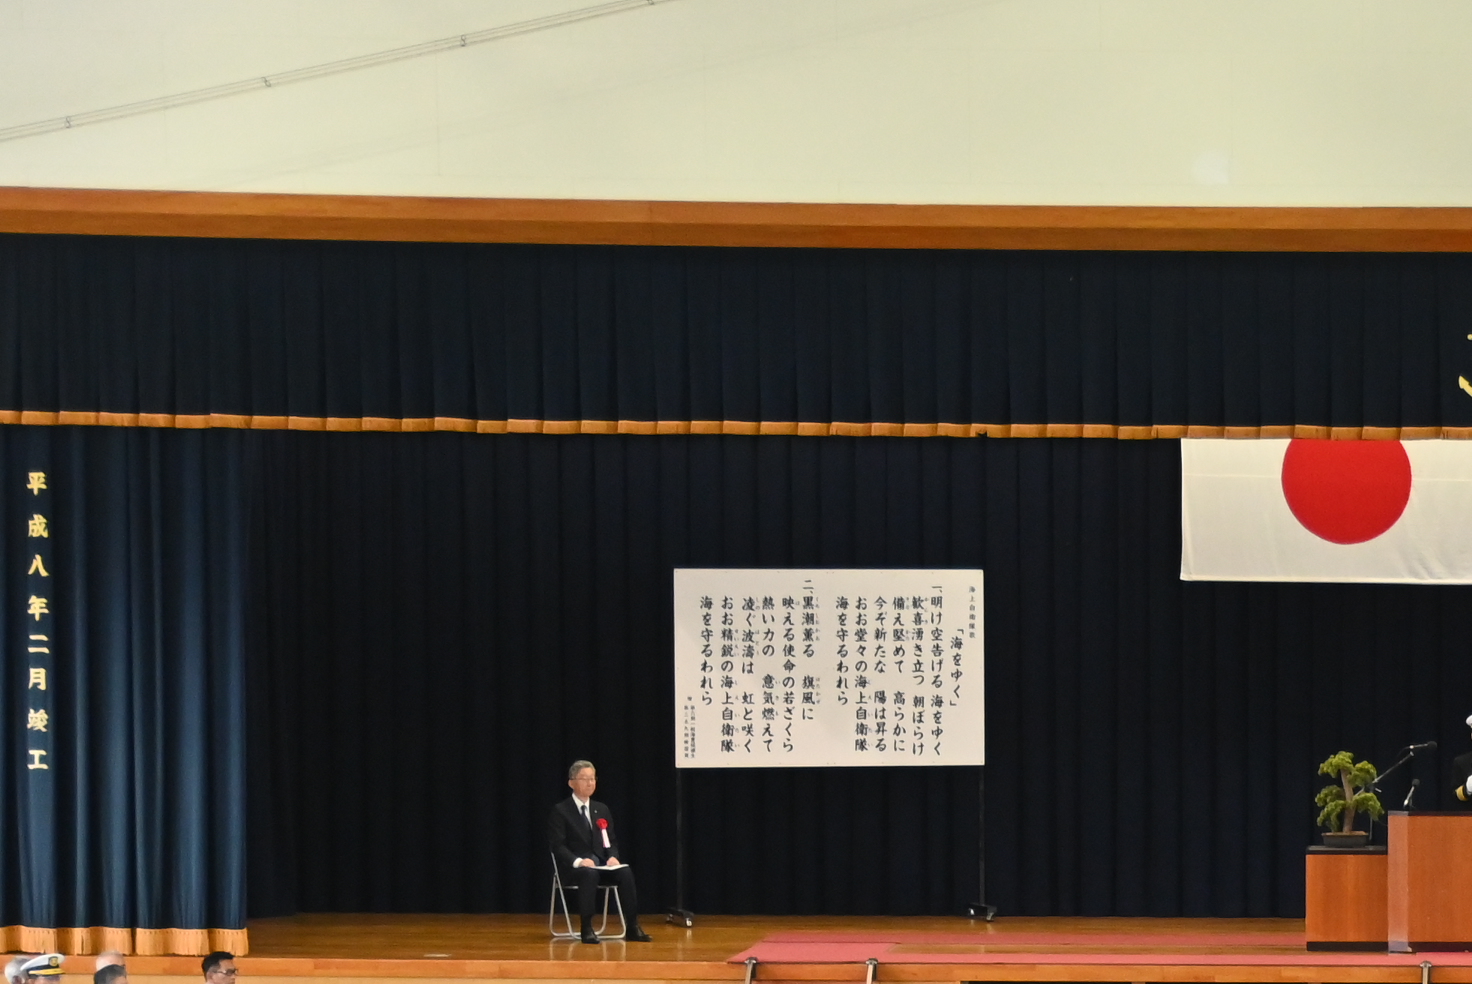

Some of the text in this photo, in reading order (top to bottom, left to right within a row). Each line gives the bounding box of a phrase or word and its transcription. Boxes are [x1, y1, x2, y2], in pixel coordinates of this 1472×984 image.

[26, 471, 49, 770] 平成八年二月竣工
[700, 596, 714, 706] 海を守るわれら
[721, 596, 735, 753] おお精鋭の海上自衛隊
[761, 596, 775, 752] 熱い力の 意気燃えて
[782, 596, 796, 753] 映える使命の若ざくら
[801, 579, 816, 720] 二、黒潮薫る 旗風に
[836, 596, 849, 706] 海を守るわれら
[855, 596, 868, 752] おお堂々の海上自衛隊
[874, 596, 888, 752] 今ぞ新たな 陽は昇る
[892, 596, 906, 752] 備え堅めて 高らかに
[911, 596, 925, 756] 歓喜湧き立つ 朝ぼらけ
[930, 586, 944, 756] 一、明け空告げる 海をゆく
[949, 628, 964, 707] 「海をゆく」
[741, 691, 755, 753] 虹と咲く
